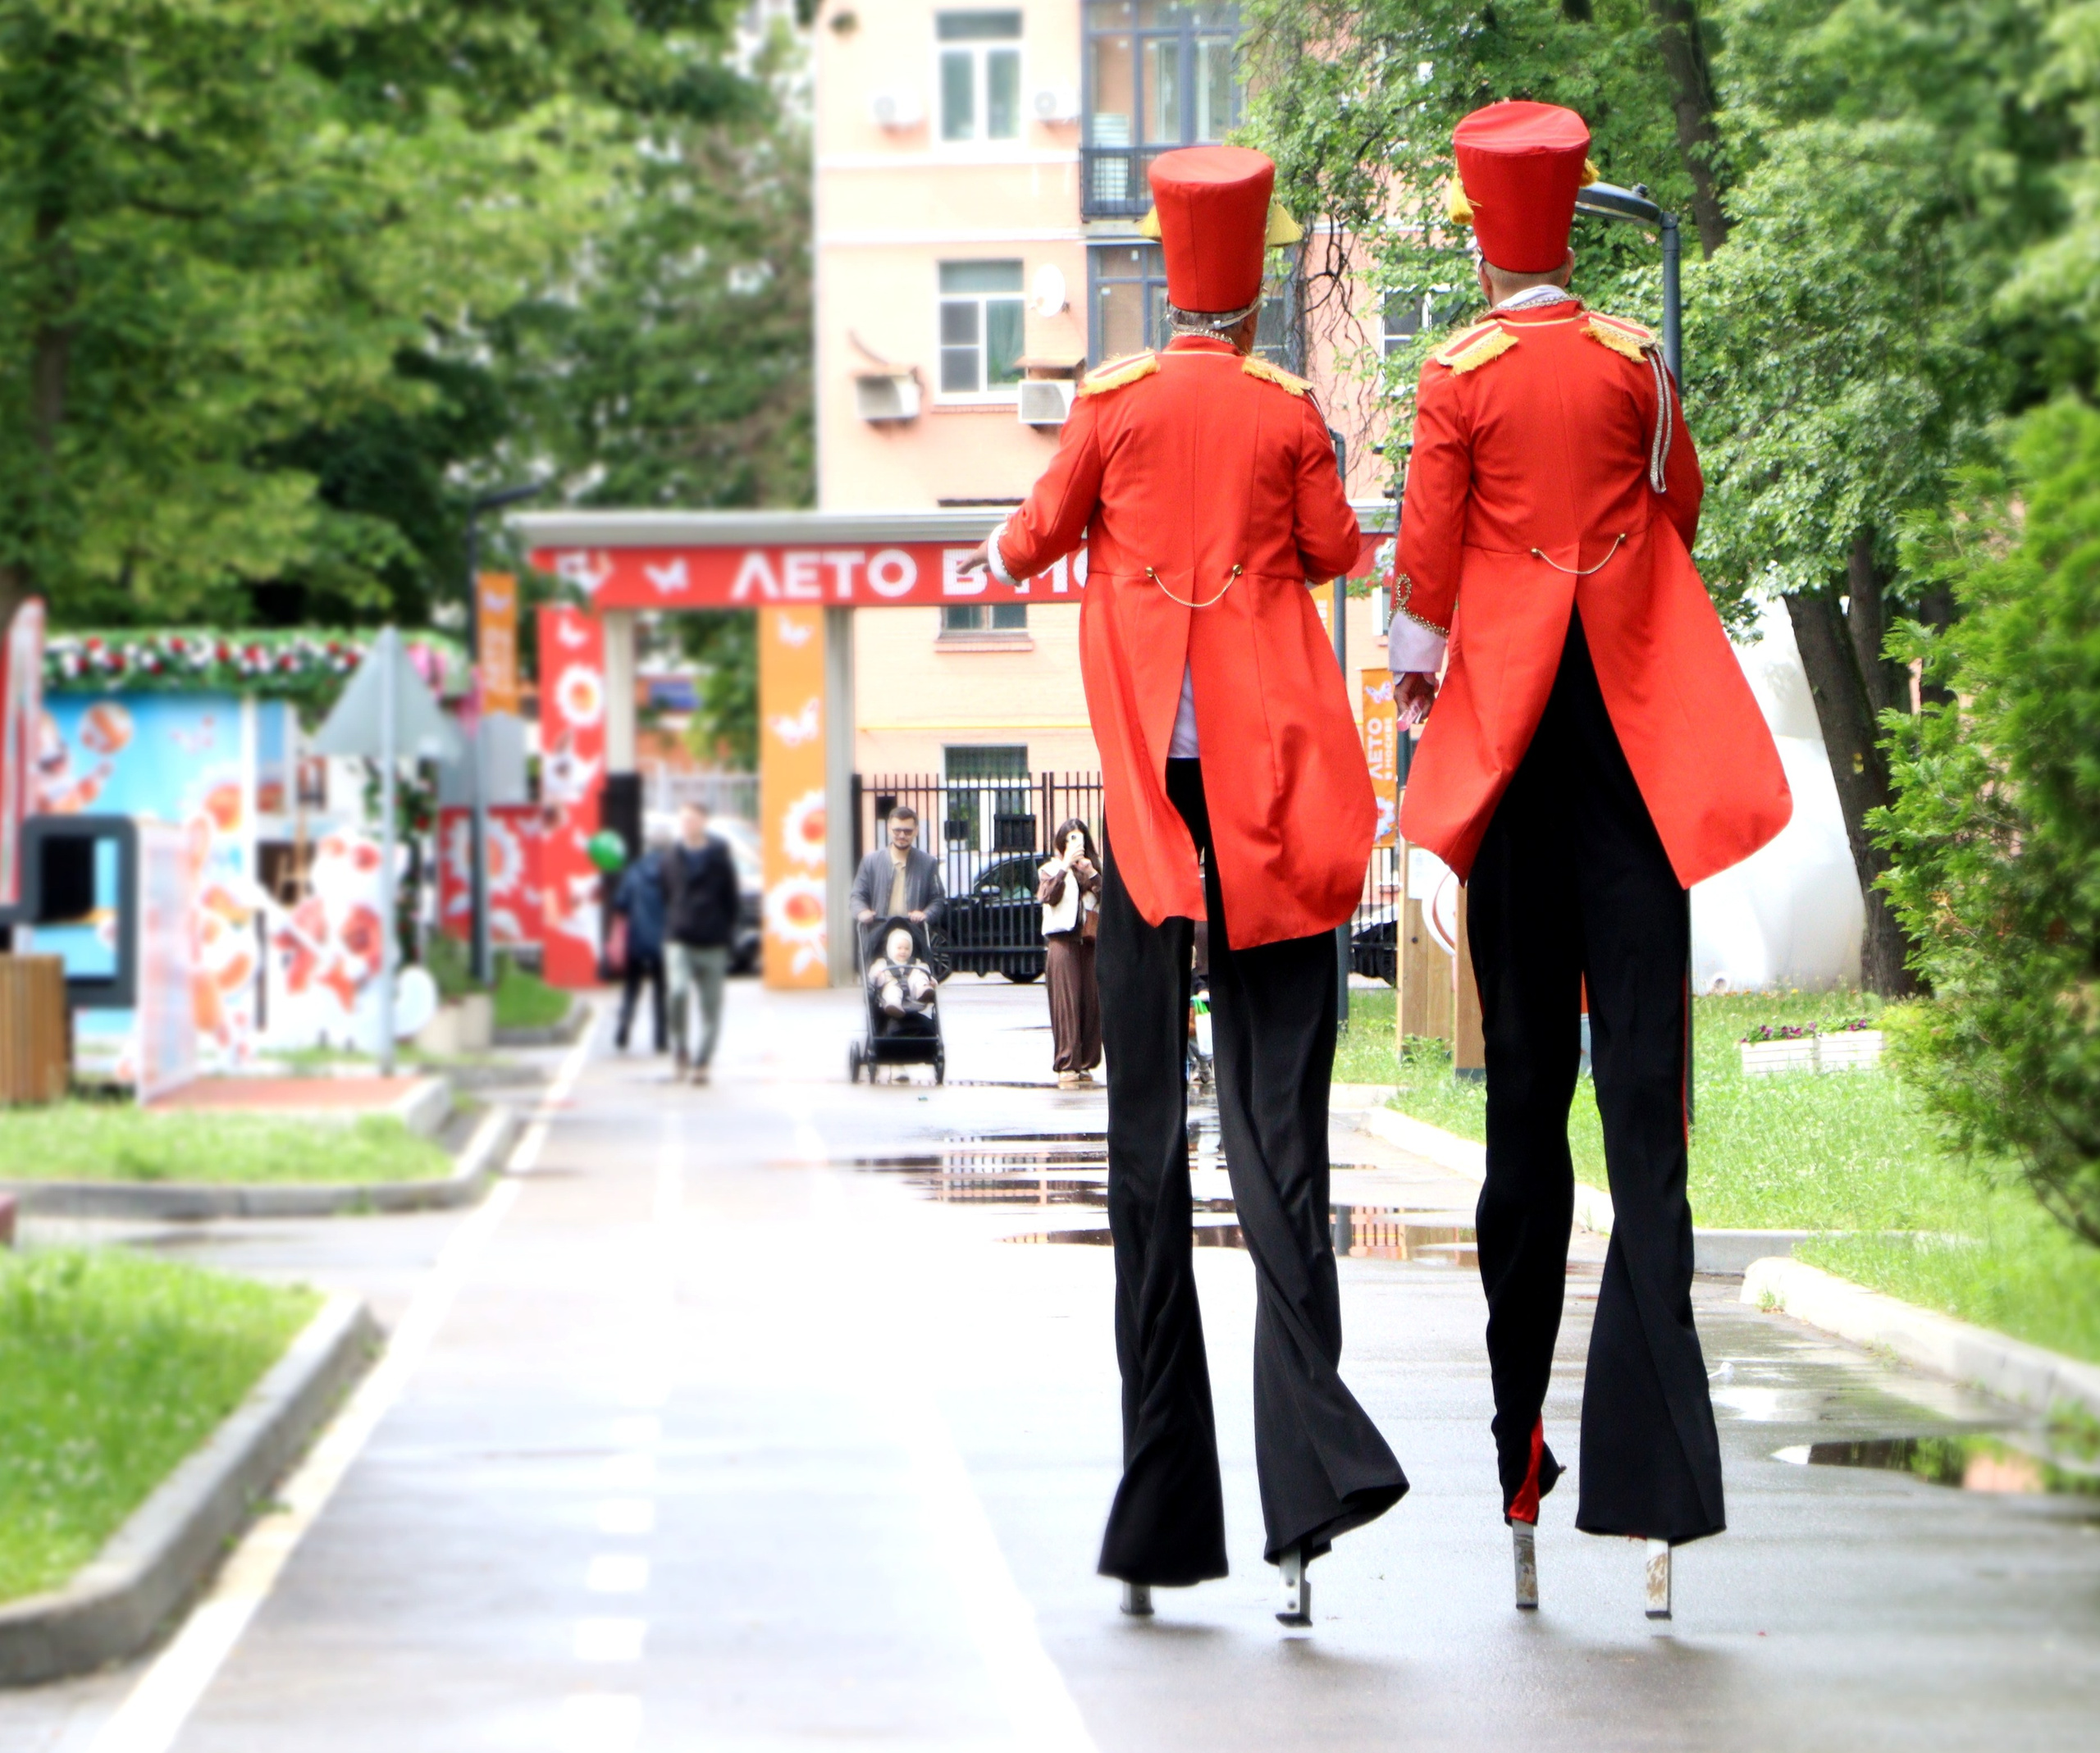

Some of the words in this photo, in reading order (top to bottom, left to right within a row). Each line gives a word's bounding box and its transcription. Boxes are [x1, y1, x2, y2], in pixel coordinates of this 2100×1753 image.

[733, 549, 918, 599] ЛЕТО
[943, 549, 988, 595] В
[1367, 717, 1383, 780] ЛЕТО
